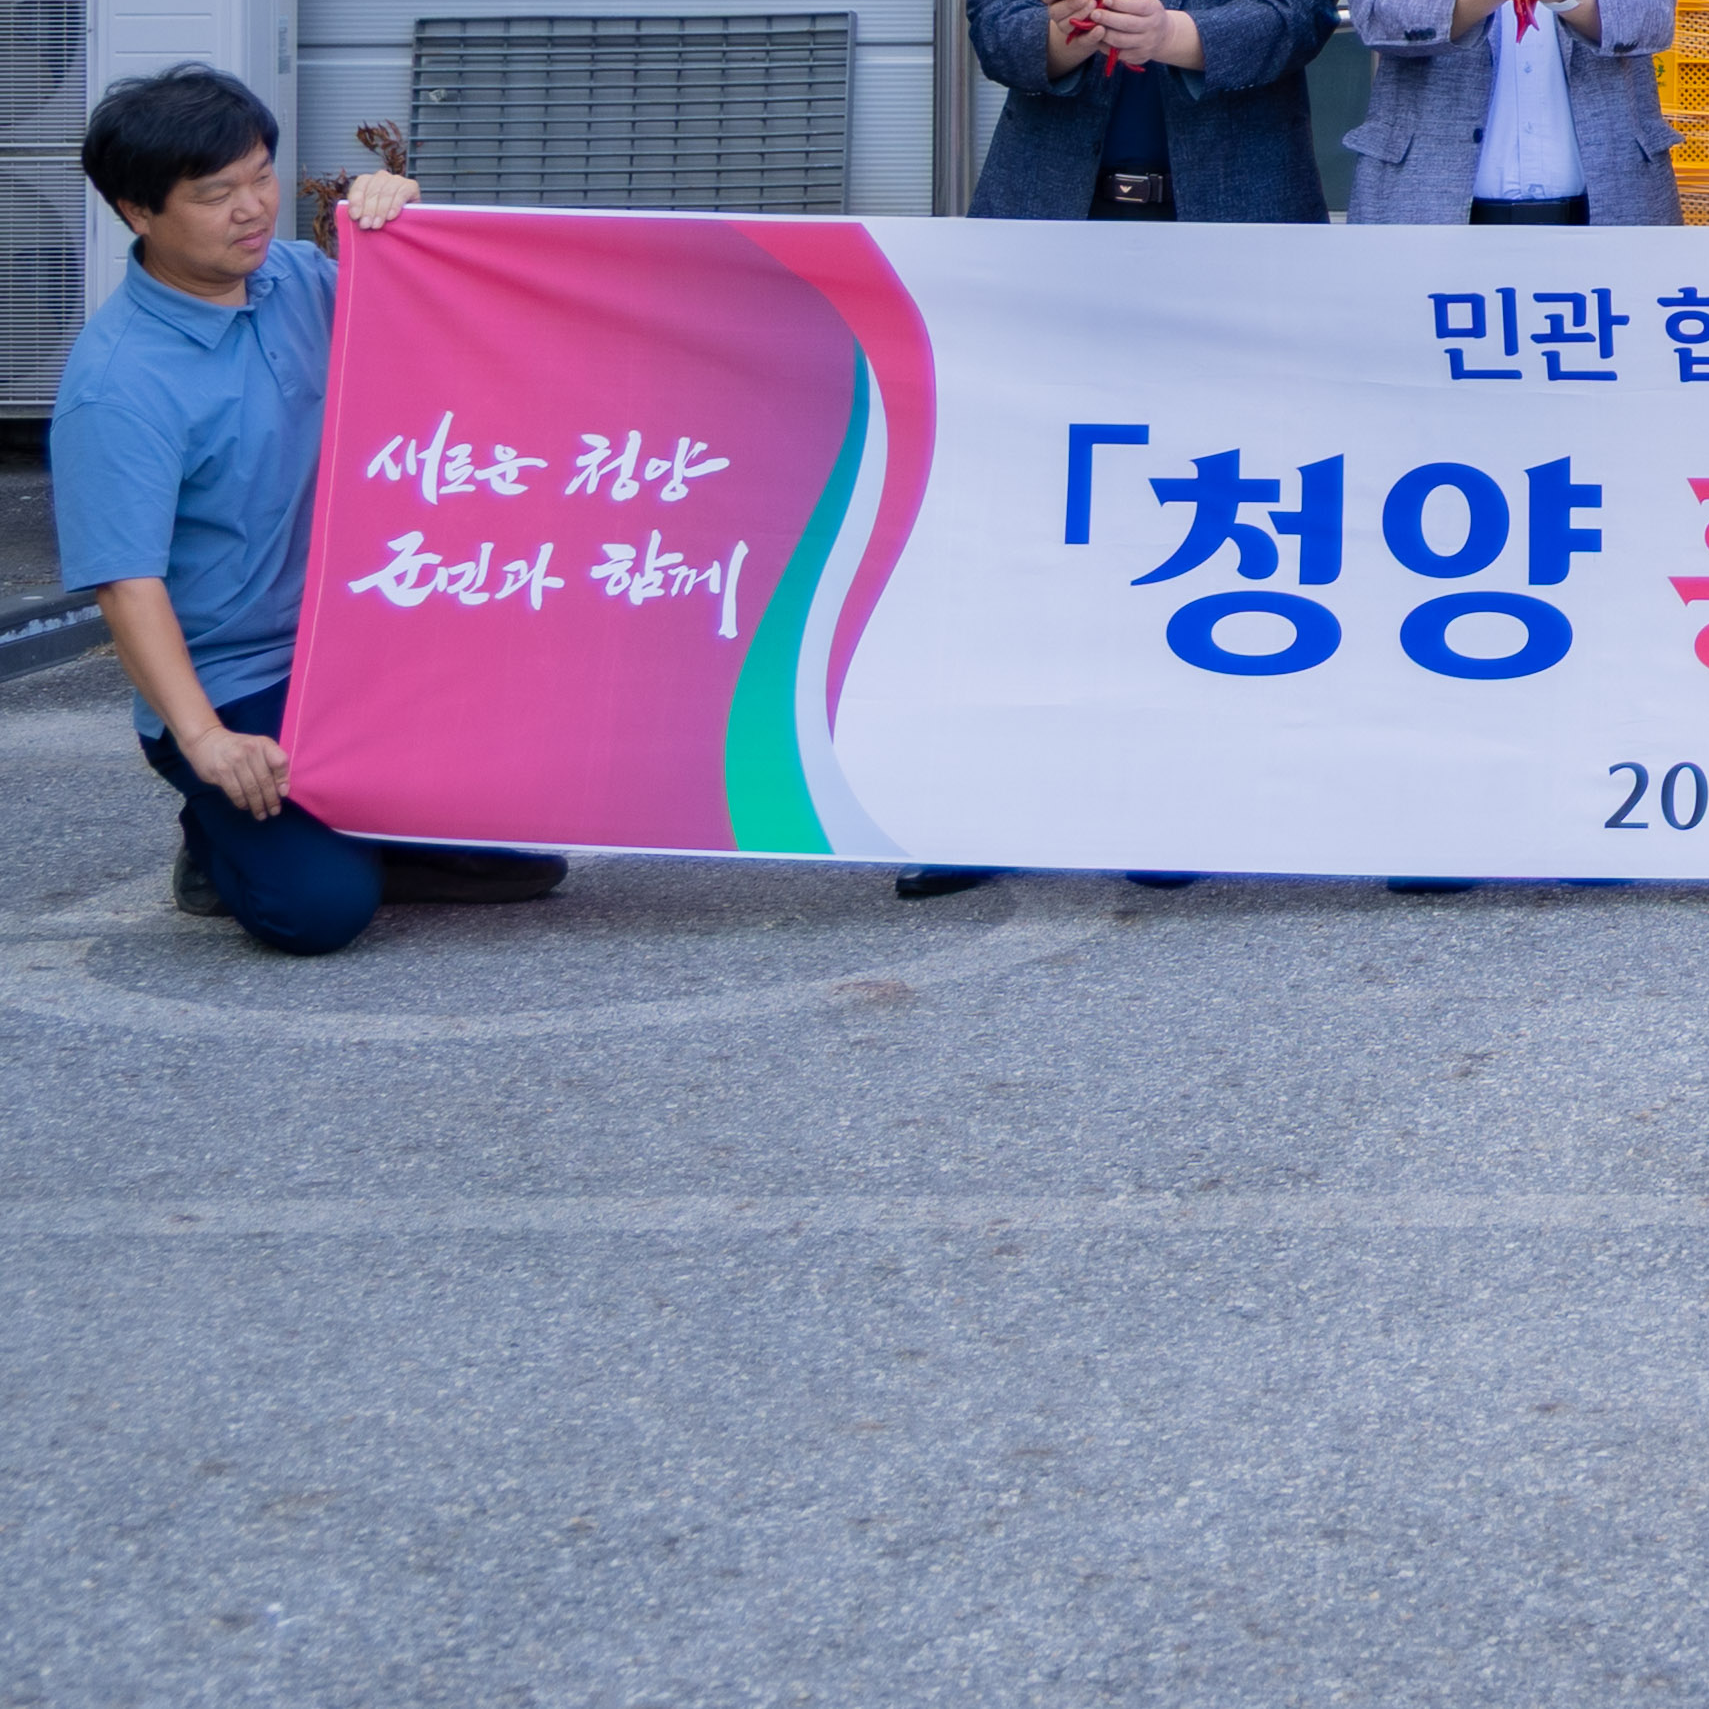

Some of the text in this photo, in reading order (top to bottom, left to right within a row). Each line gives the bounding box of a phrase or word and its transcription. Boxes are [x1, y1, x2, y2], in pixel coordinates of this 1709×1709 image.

[1428, 287, 1630, 382] 민관
[367, 411, 730, 505] 새로운 청양
[348, 529, 749, 640] 군민과 함께
[1063, 423, 1602, 681] 「청양
